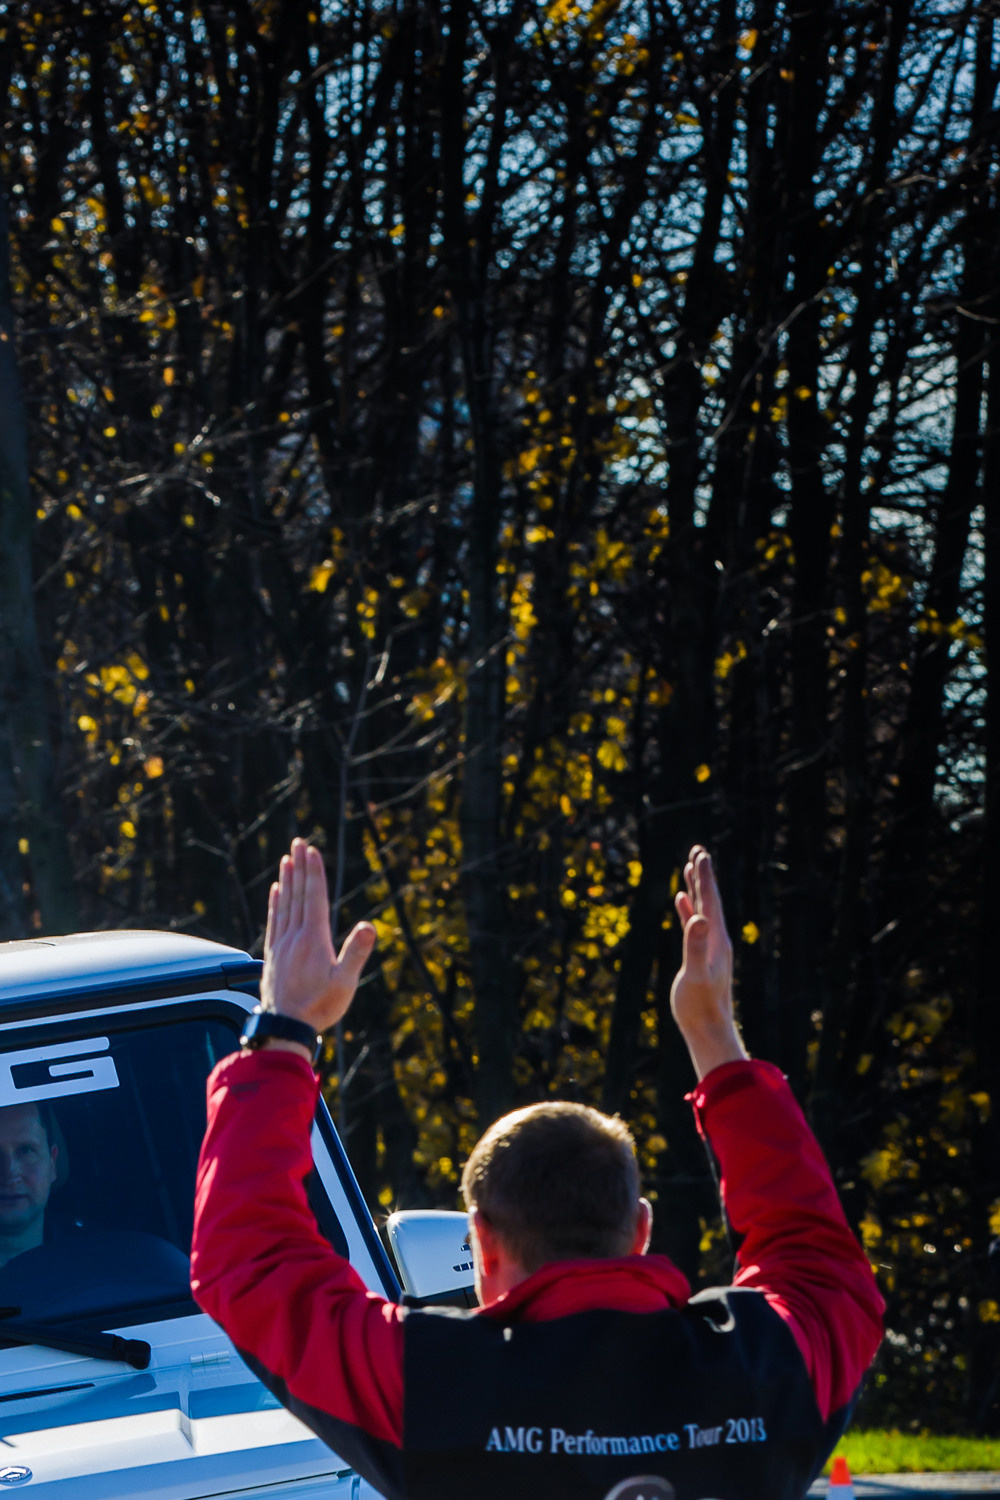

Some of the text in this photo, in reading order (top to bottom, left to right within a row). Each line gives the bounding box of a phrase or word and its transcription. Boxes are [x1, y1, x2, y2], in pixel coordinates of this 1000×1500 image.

[486, 1416, 767, 1456] AMG Performance Tour 2013
